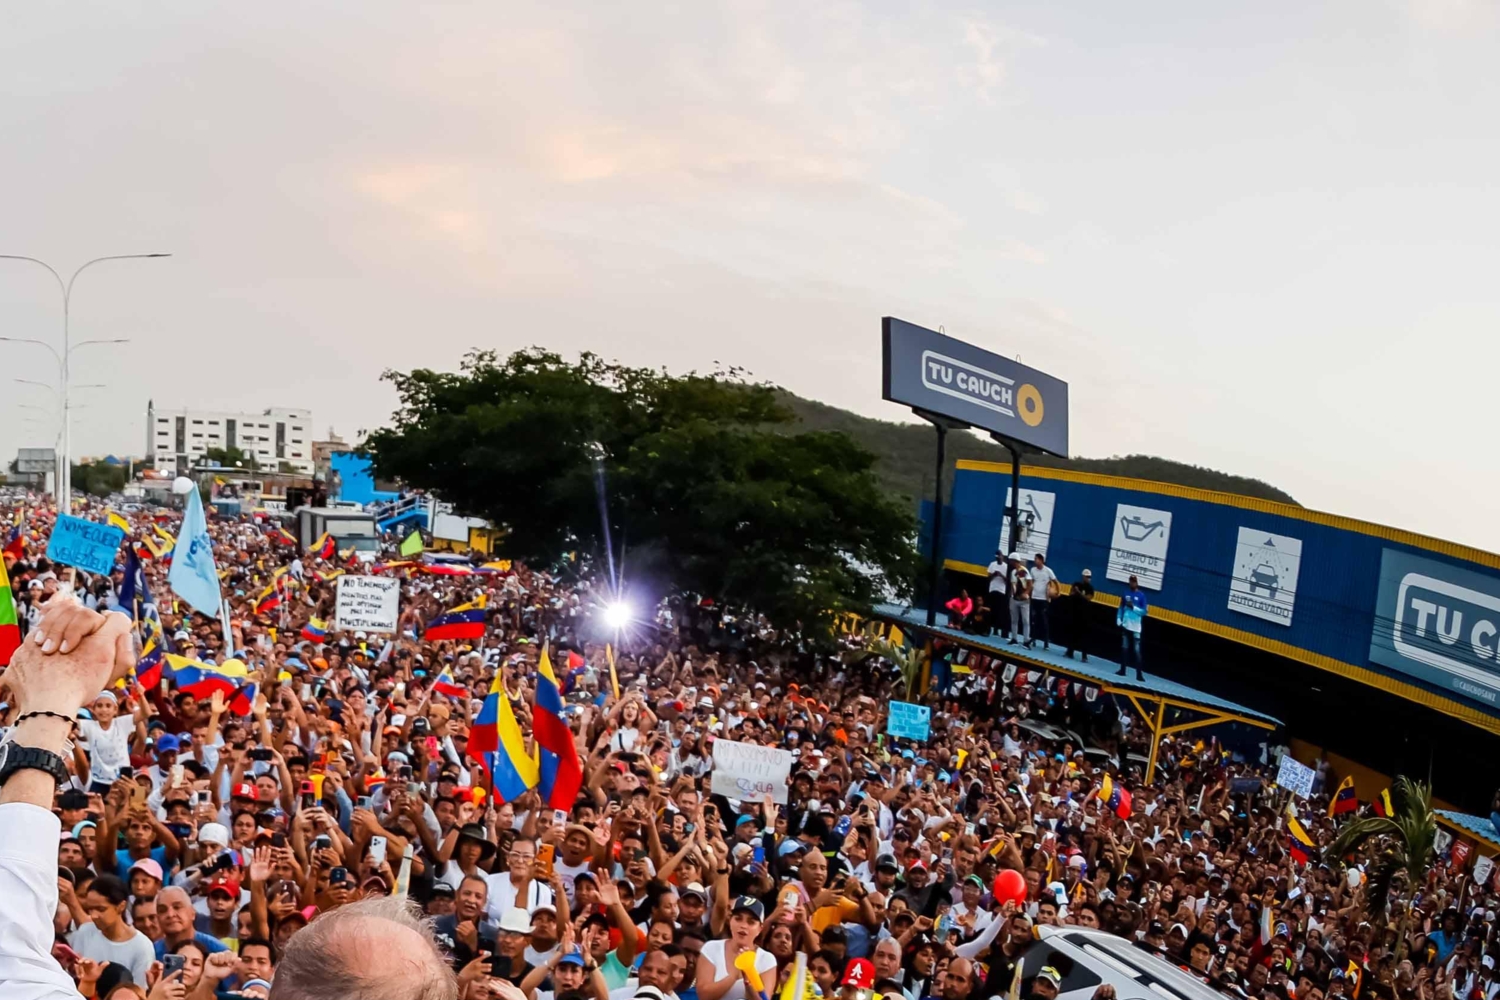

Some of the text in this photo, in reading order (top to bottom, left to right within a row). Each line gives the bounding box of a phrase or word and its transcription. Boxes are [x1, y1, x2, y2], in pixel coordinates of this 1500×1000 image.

[928, 361, 953, 384] TU
[1116, 549, 1159, 567] CAMBIO DE
[1230, 594, 1289, 618] AUTOLAVADO
[1411, 598, 1500, 664] TU C
